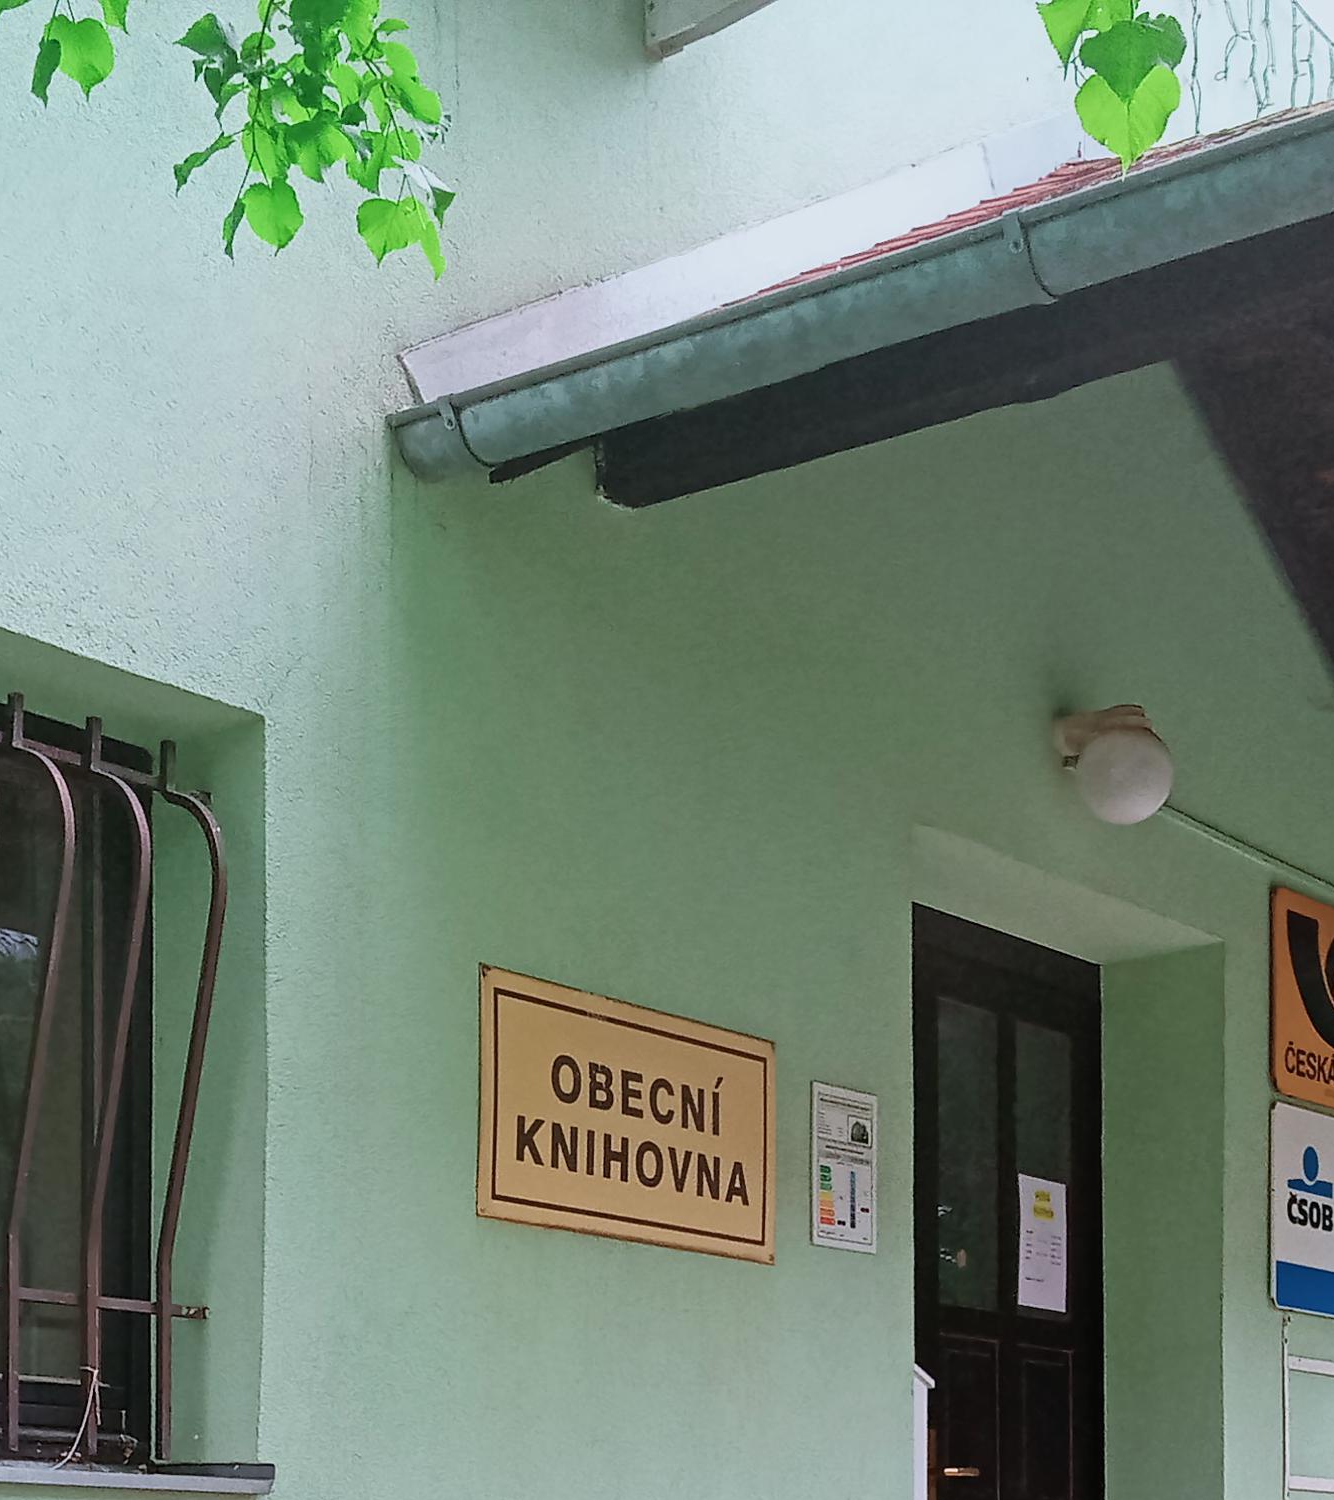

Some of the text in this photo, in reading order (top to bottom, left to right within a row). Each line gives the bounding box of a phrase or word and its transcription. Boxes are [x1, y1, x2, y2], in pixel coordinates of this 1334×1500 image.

[551, 1055, 723, 1136] OBECNÍ
[516, 1115, 749, 1206] KNIHOVNA
[1287, 1191, 1333, 1232] ČSOB
